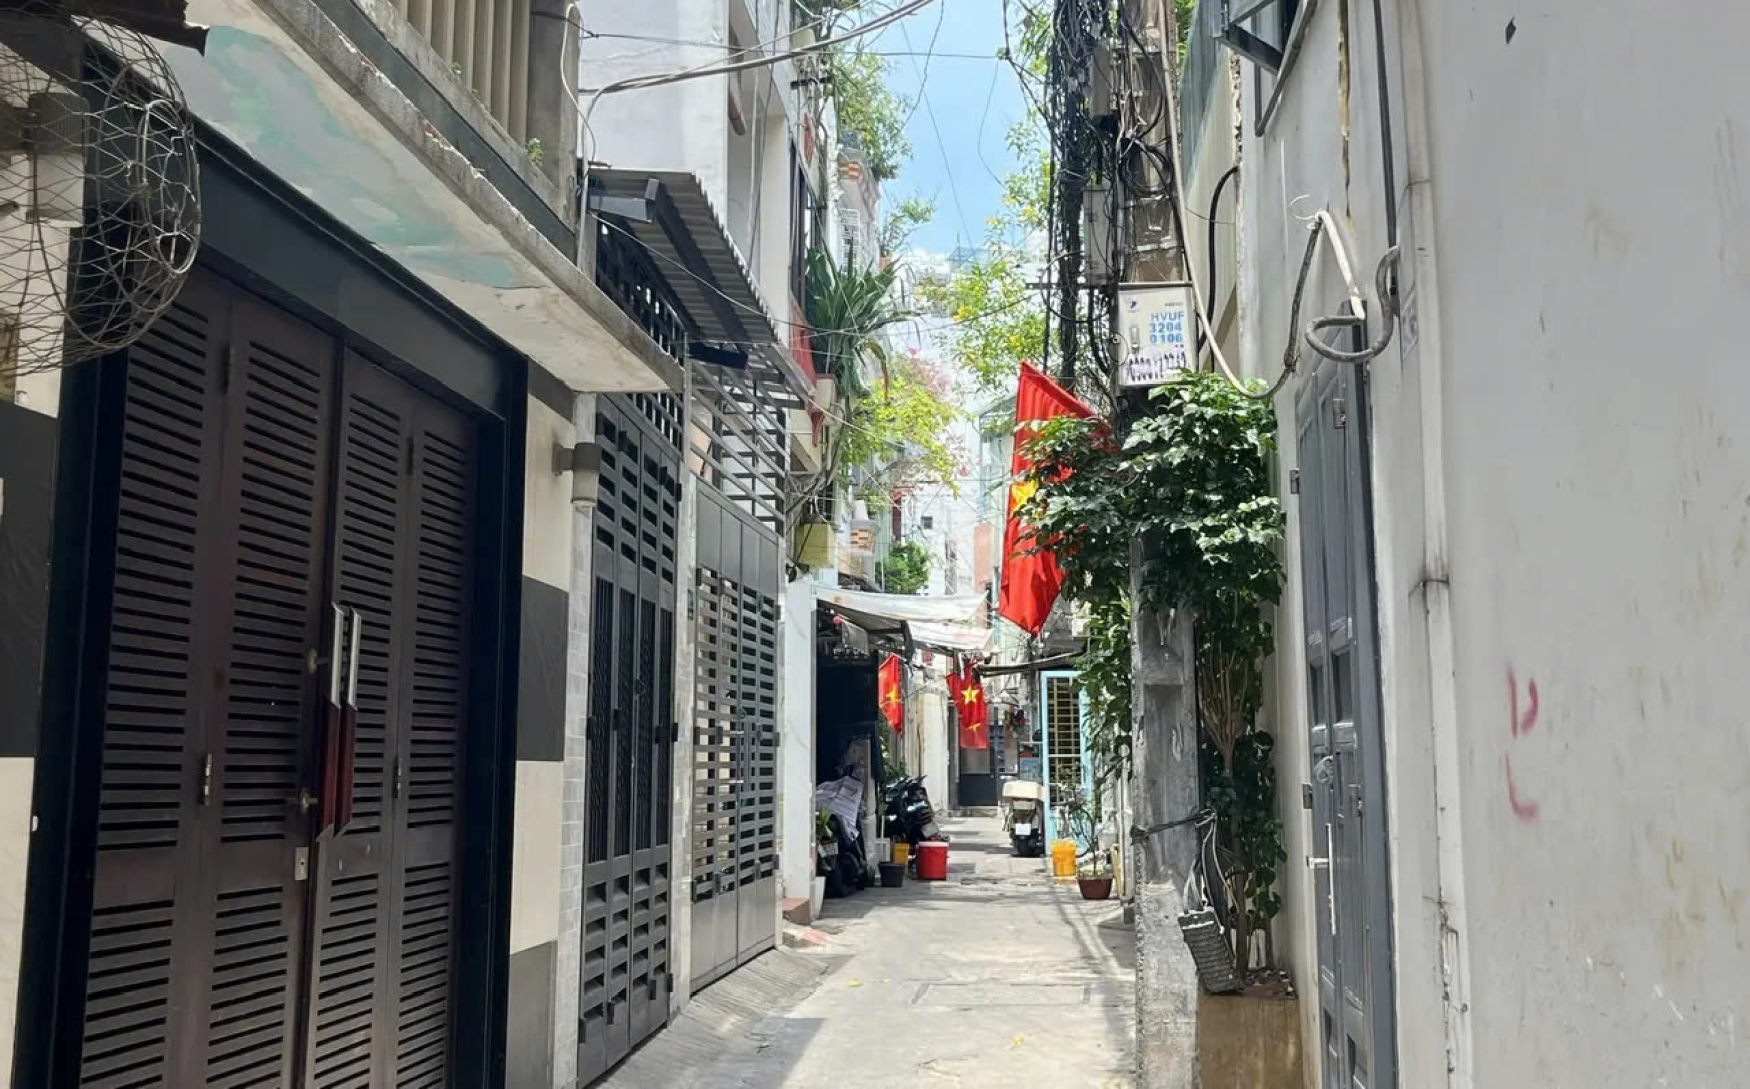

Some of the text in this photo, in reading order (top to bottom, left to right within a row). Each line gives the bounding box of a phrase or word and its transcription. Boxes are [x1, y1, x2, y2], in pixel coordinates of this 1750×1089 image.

[1150, 311, 1184, 321] HVUF
[1149, 322, 1182, 332] 3204
[1150, 333, 1182, 343] 0106
